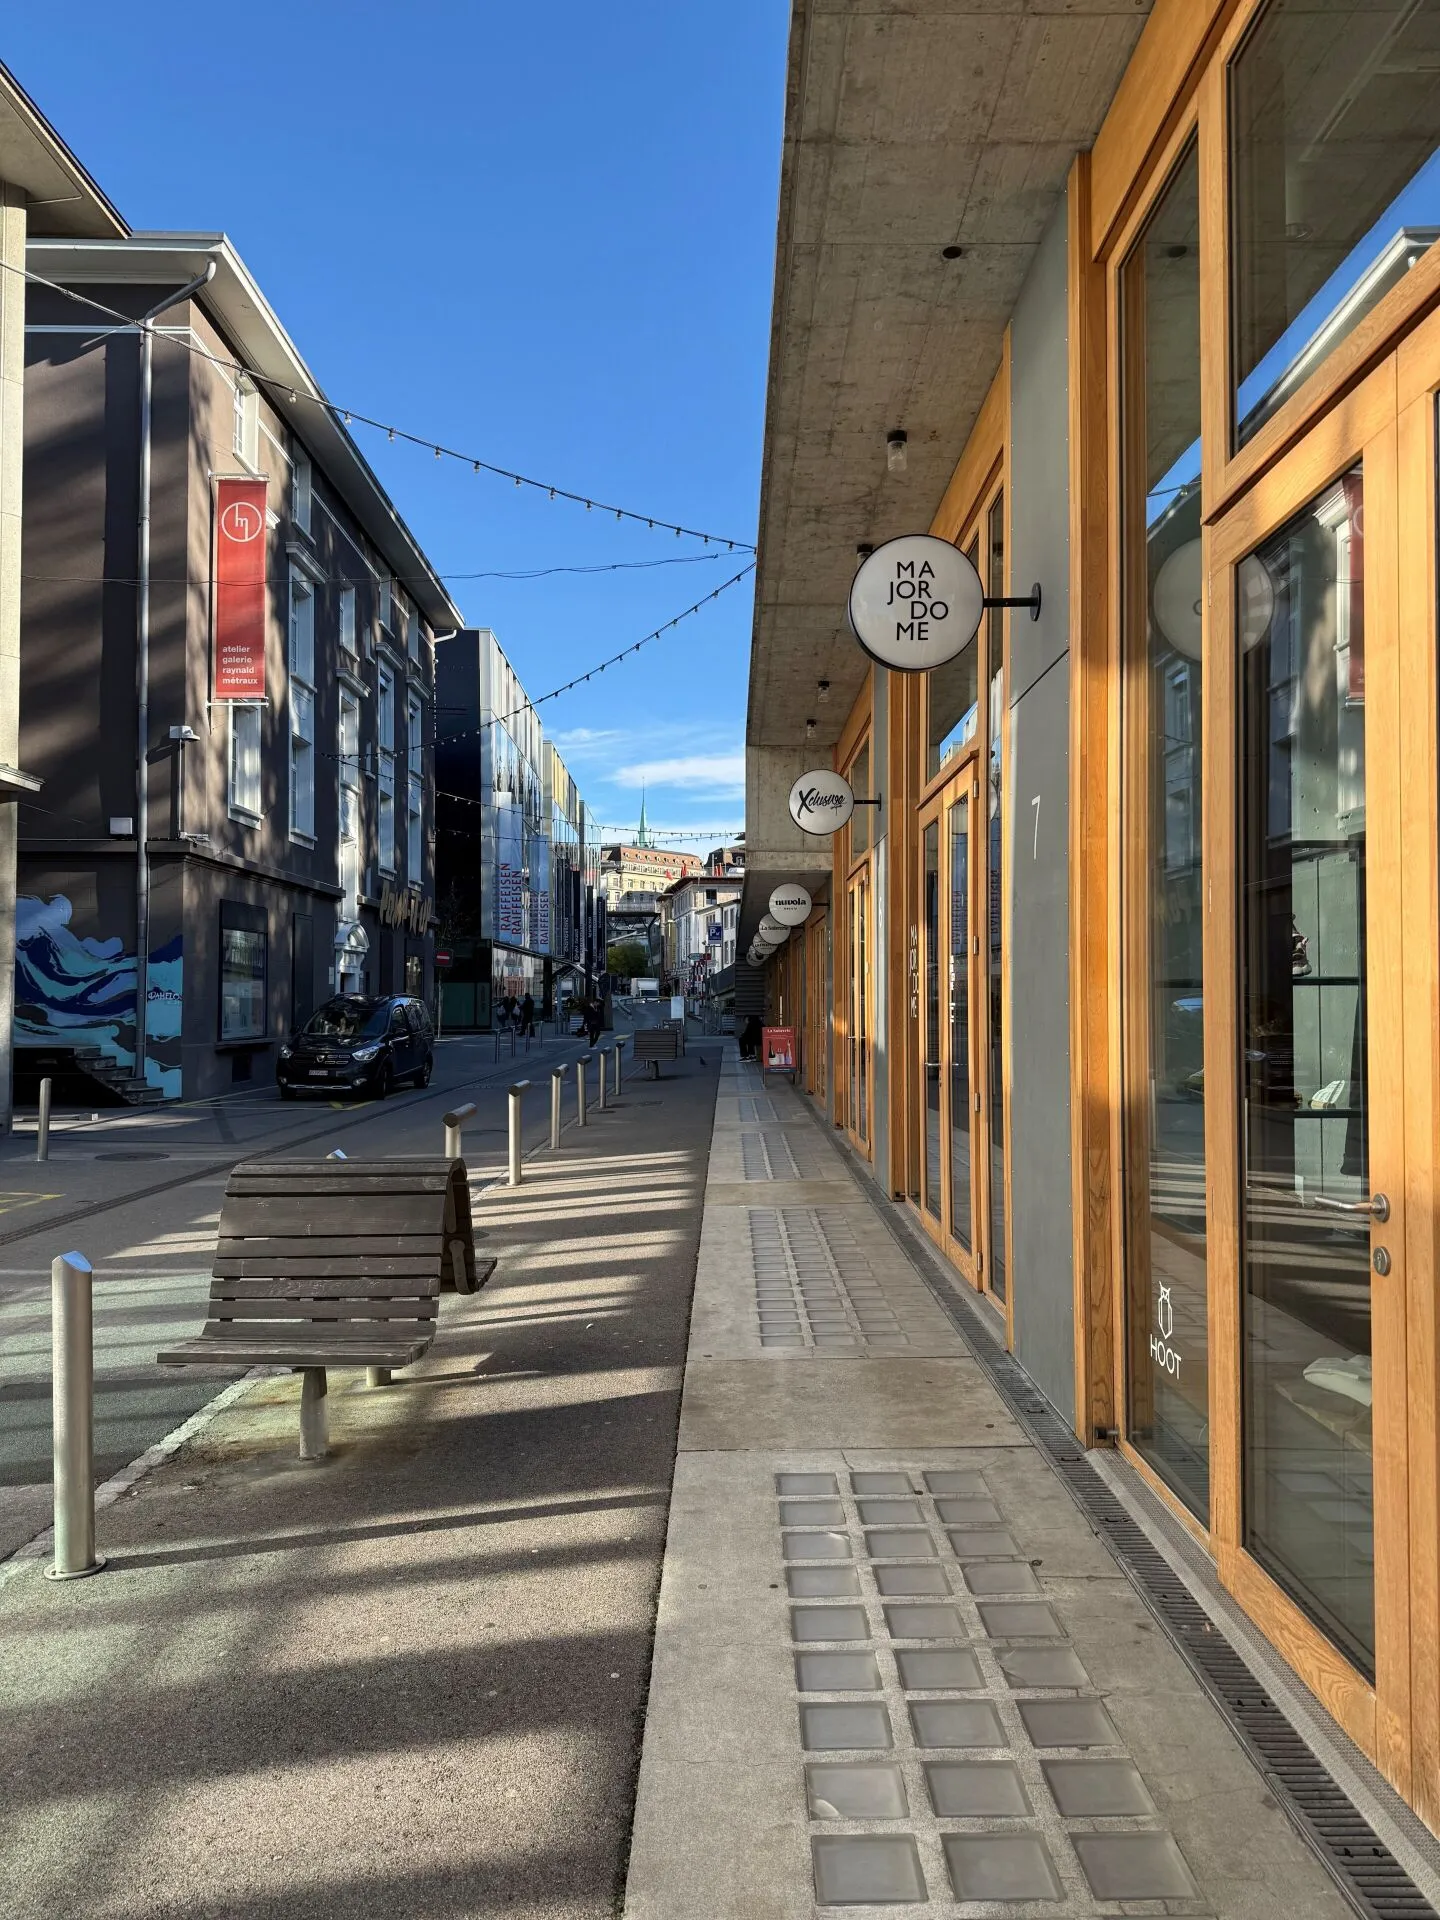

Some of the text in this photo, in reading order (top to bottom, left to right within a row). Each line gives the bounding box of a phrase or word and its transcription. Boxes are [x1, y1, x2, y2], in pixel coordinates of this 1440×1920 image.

[896, 560, 935, 579] MA
[887, 580, 932, 605] JOR
[910, 601, 949, 620] DO
[896, 622, 929, 641] ME
[222, 645, 250, 653] atelier
[222, 656, 252, 664] galerie
[222, 667, 255, 675] raynald
[222, 676, 258, 685] métraux
[500, 863, 511, 931] RAIFFEISEN
[511, 870, 522, 935] RAIFFEISEN
[775, 898, 806, 906] nuvola
[540, 890, 549, 945] RAIFFEISEN
[1149, 1333, 1182, 1380] HOOT
